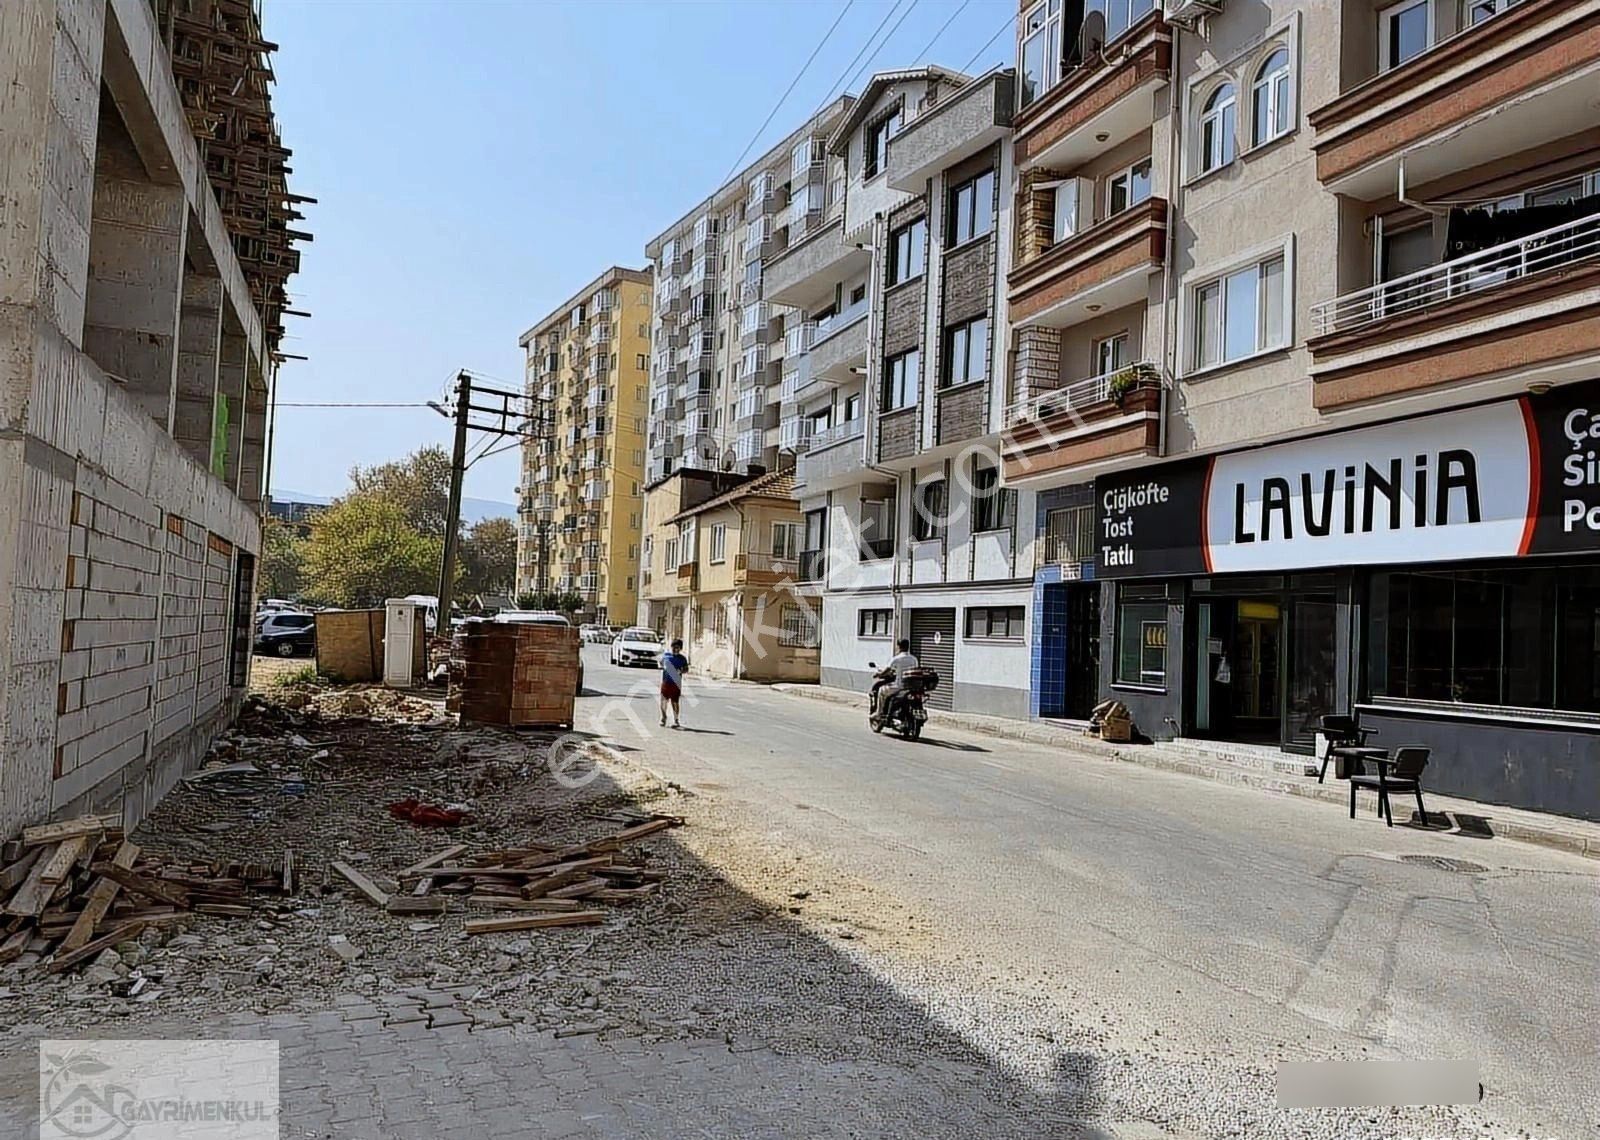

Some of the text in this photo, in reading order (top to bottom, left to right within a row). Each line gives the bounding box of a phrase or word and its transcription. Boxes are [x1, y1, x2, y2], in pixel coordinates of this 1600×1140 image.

[1563, 451, 1600, 487] Si
[1103, 482, 1169, 516] Çiğköfte
[1102, 516, 1133, 538] Tost
[1102, 543, 1134, 567] Tatlı
